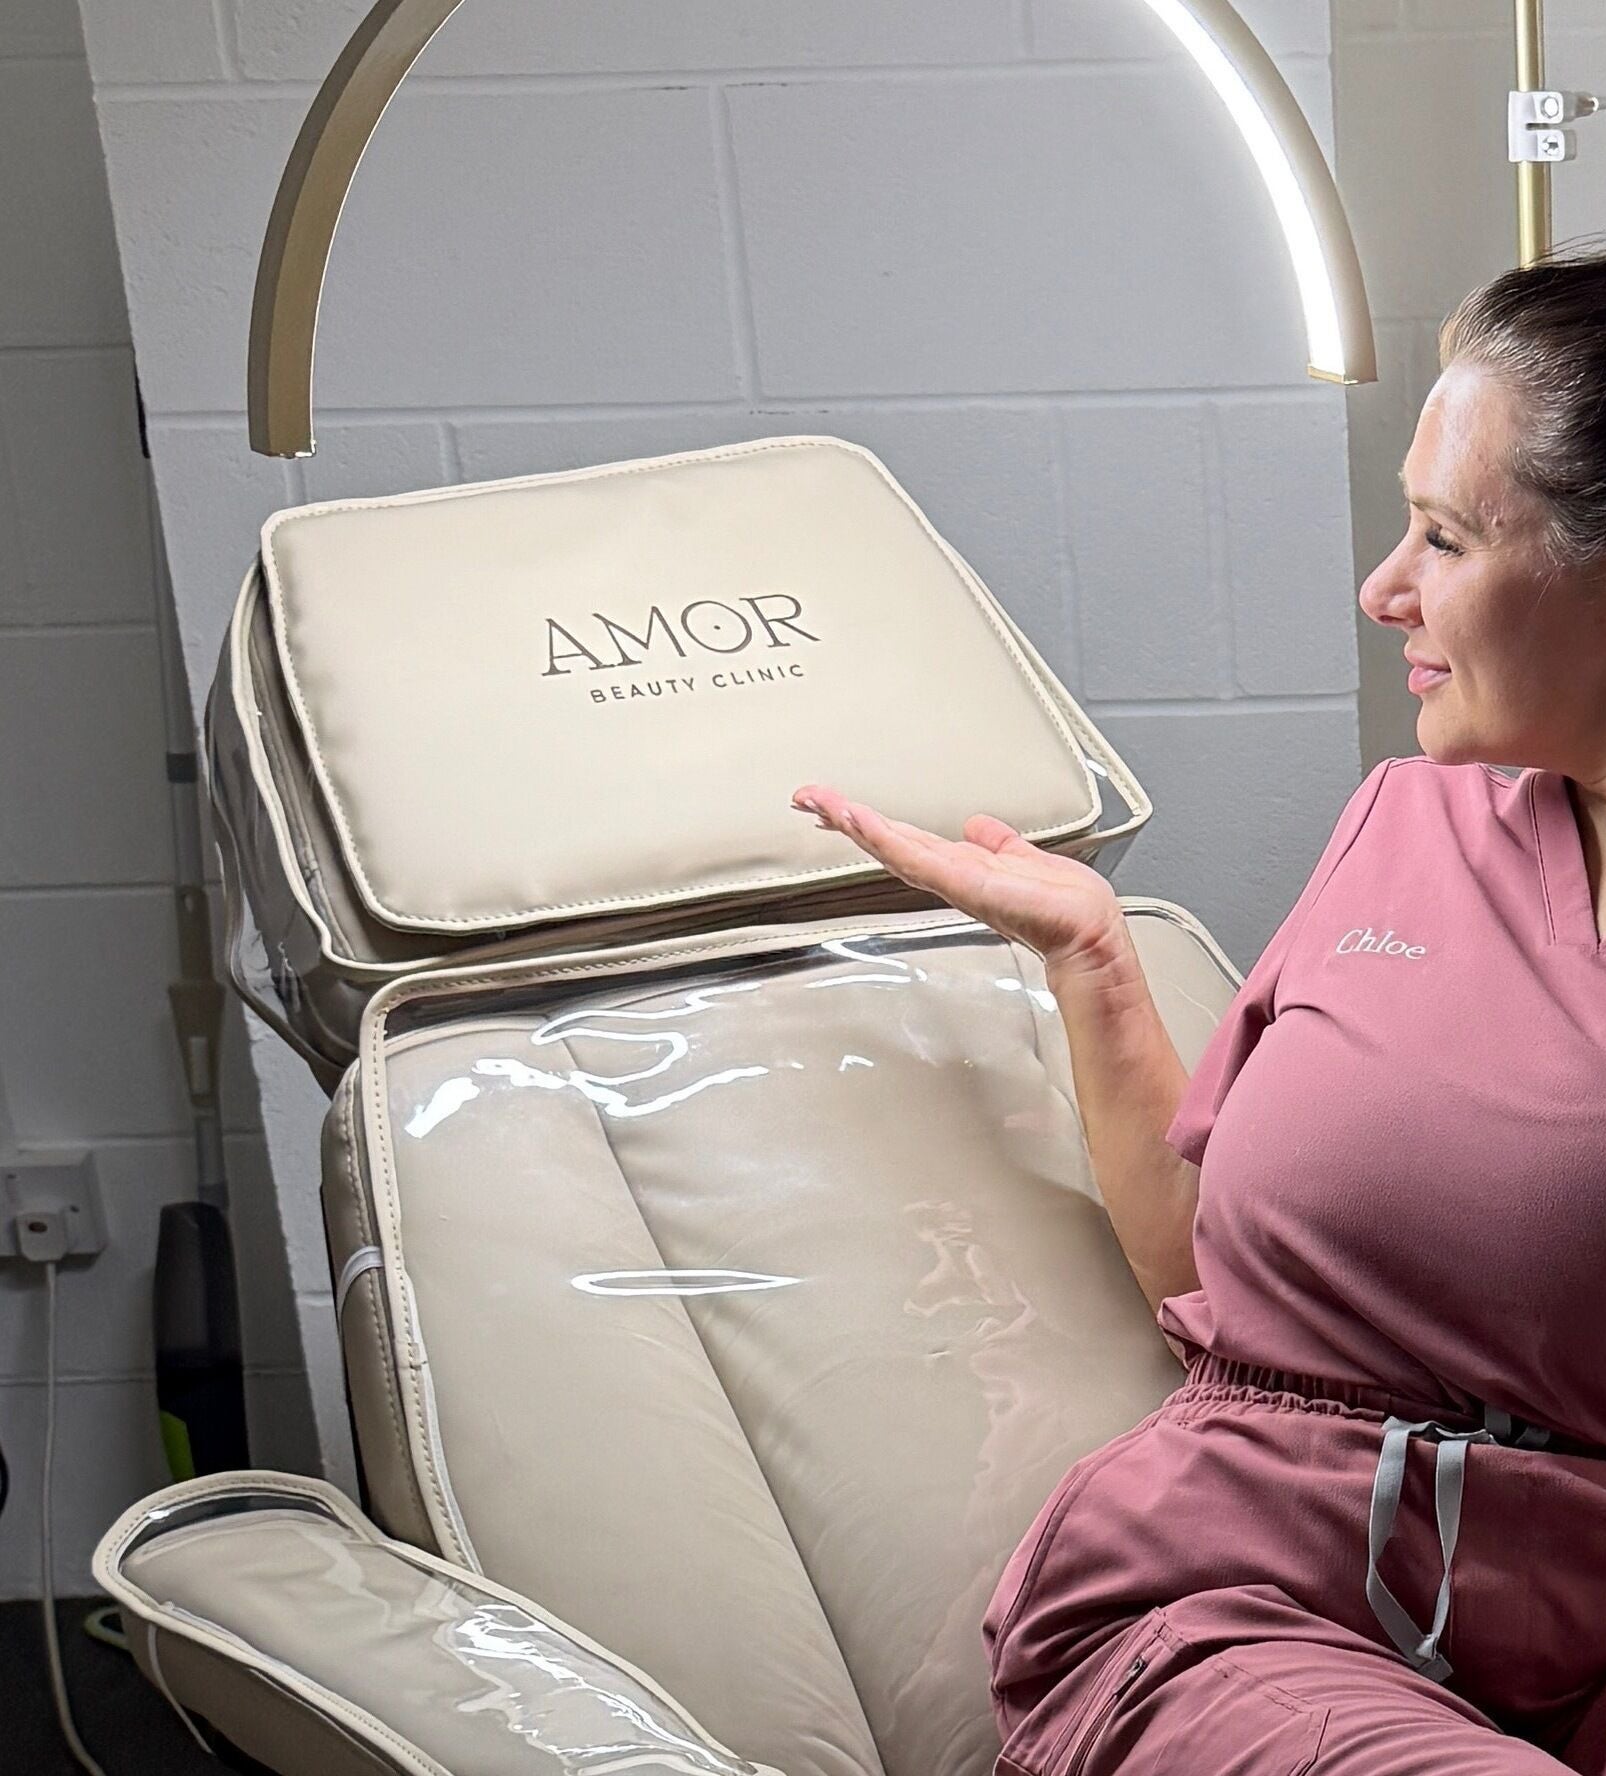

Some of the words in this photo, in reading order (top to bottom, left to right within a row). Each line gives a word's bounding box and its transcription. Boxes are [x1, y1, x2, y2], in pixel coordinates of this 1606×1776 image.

[541, 594, 821, 676] AMOR
[590, 677, 695, 703] BEAUTY
[712, 664, 805, 688] CLINIC
[1336, 927, 1426, 959] Chloe
